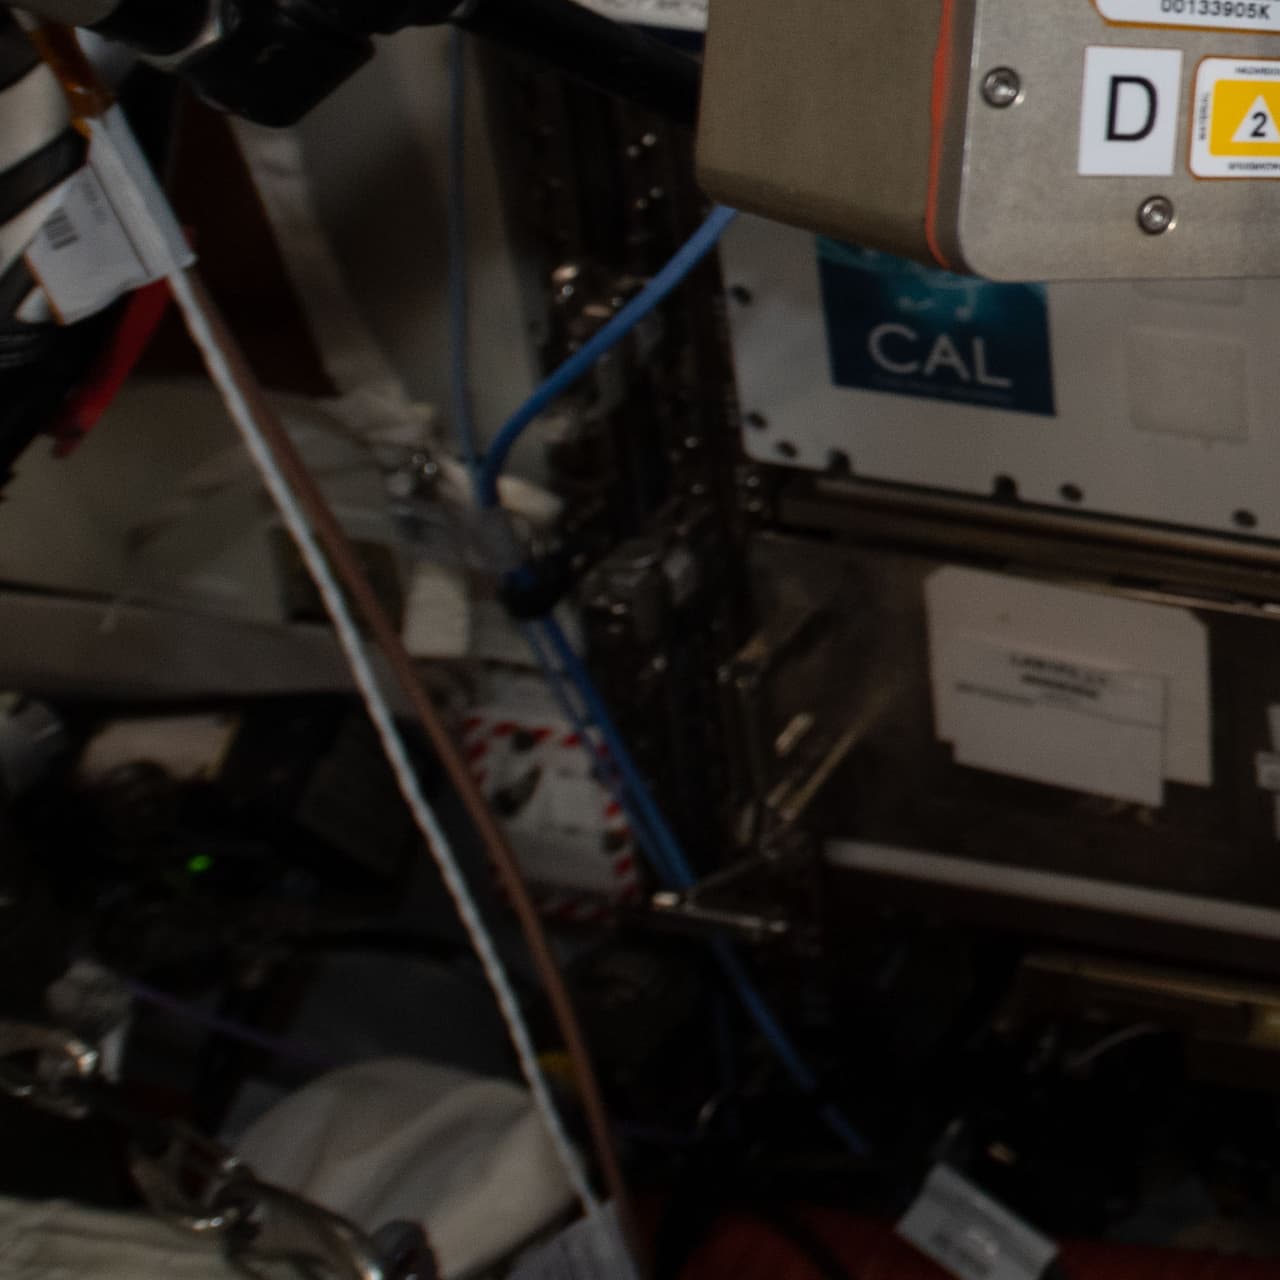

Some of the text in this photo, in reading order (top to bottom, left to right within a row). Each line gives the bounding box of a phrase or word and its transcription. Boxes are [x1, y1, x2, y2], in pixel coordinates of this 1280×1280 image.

[1106, 75, 1158, 141] D
[1249, 112, 1269, 139] 2
[867, 322, 1014, 389] CAL
